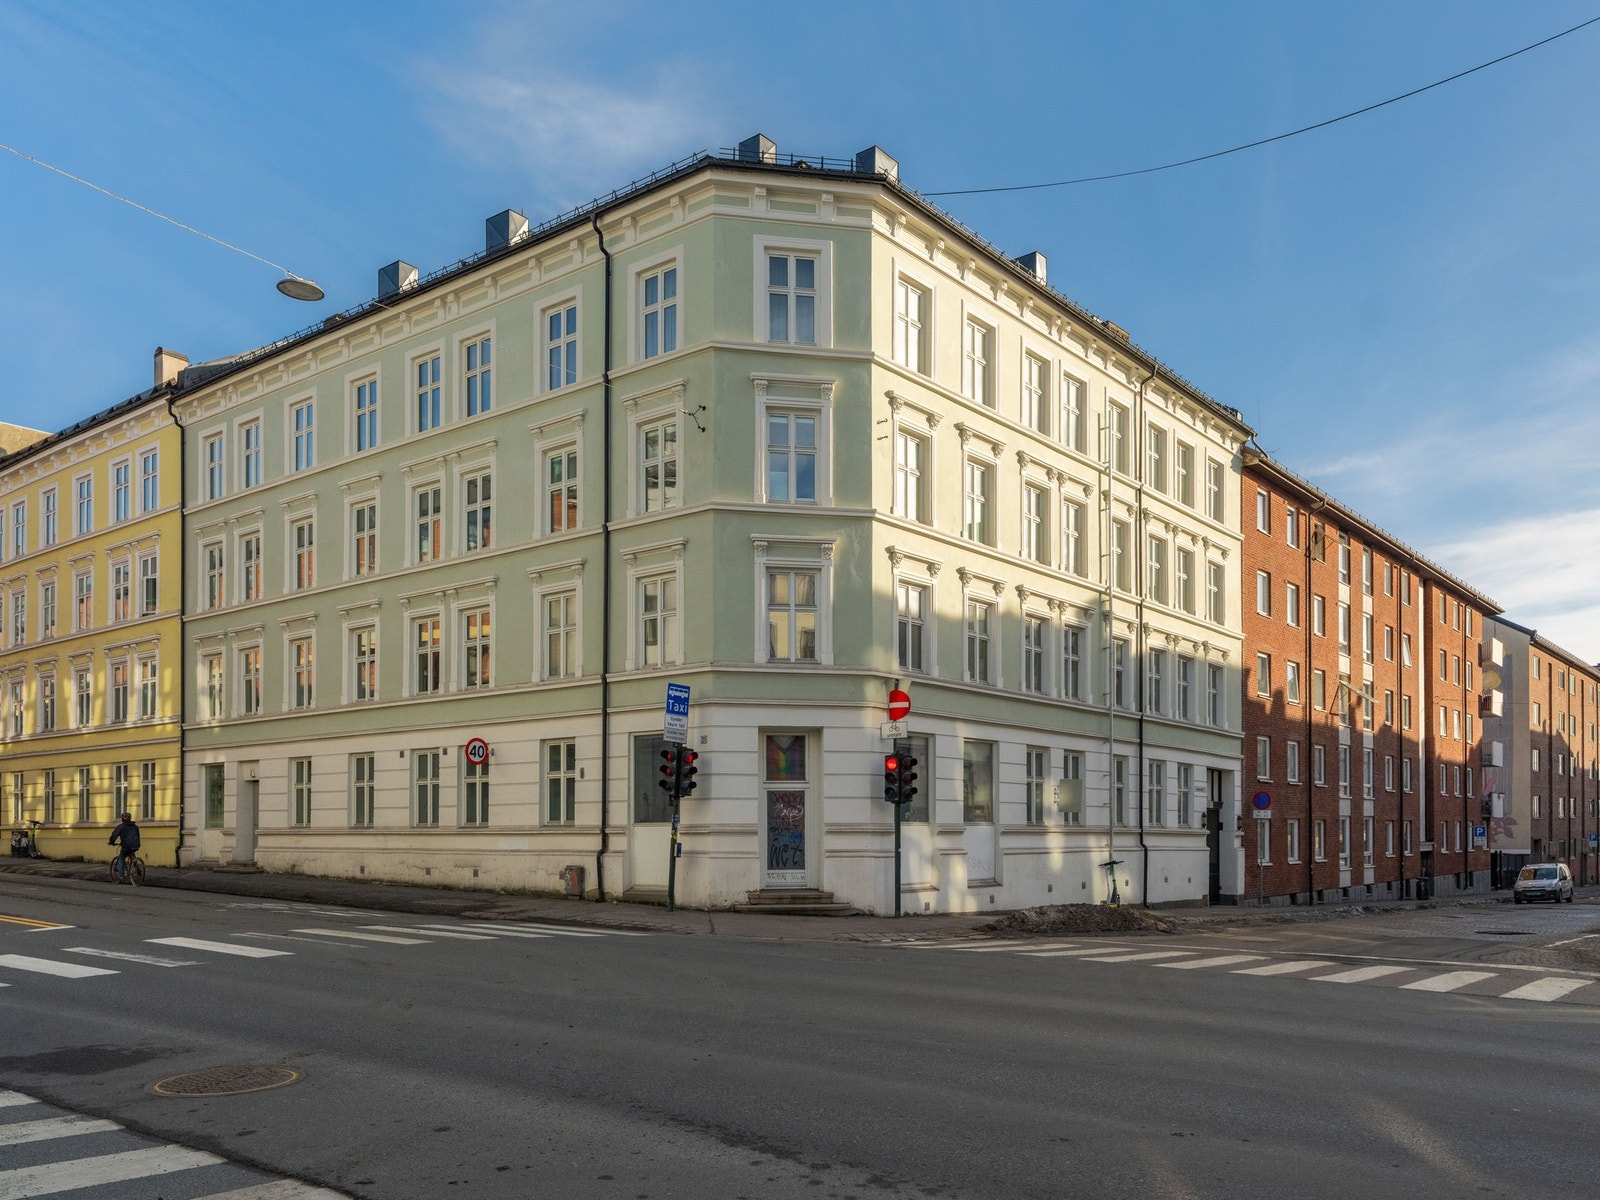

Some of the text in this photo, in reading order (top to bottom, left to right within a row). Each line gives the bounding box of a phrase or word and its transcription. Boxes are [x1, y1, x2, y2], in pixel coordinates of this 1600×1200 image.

[668, 699, 688, 713] Taxi
[469, 745, 485, 758] 40
[1476, 827, 1483, 836] P
